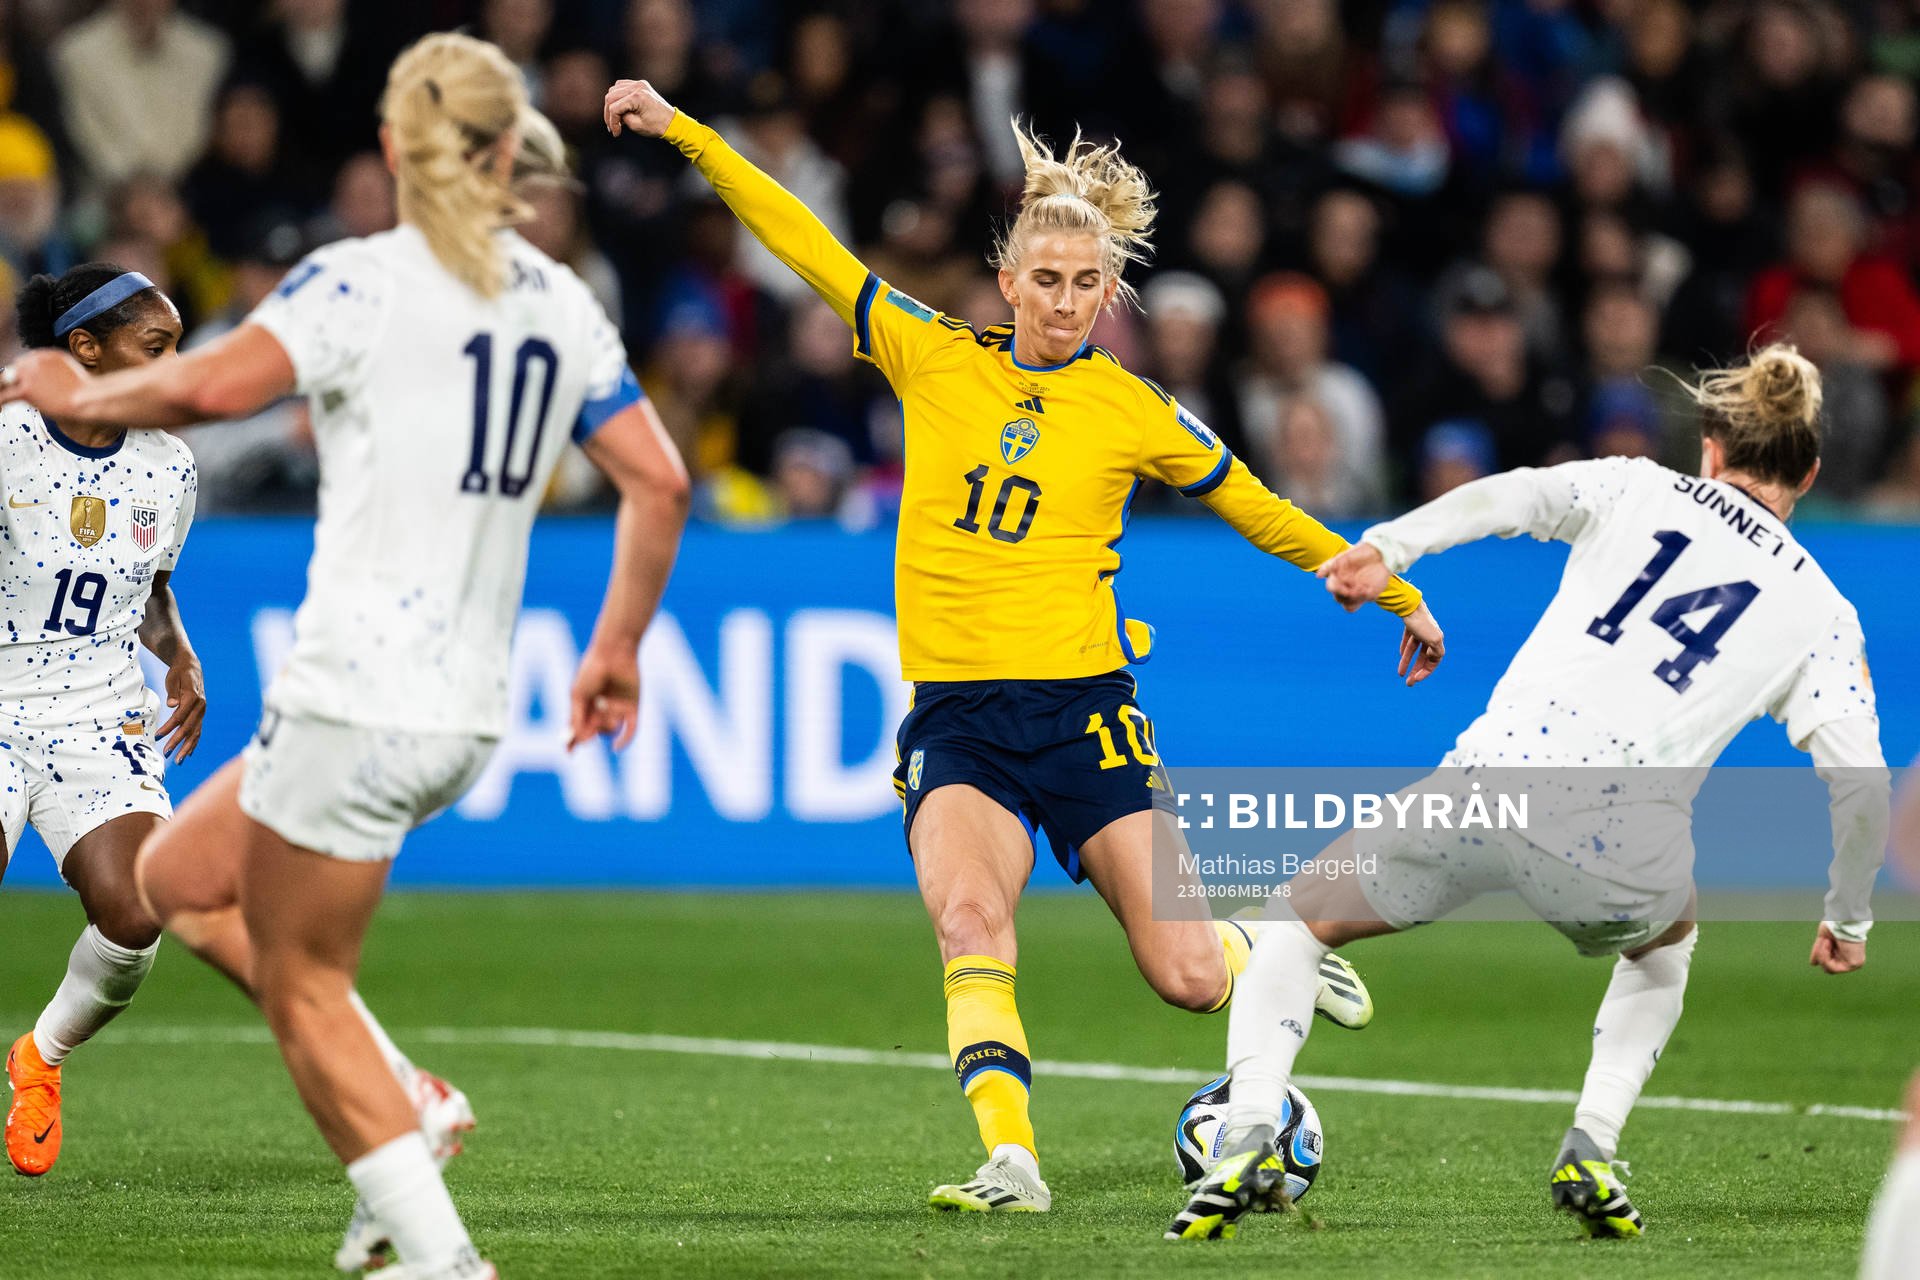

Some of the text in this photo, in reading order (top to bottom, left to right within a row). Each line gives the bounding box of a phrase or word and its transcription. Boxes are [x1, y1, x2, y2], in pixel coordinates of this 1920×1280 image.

[460, 333, 558, 498] 10
[79, 528, 95, 536] FIFA
[133, 509, 156, 527] USA
[953, 463, 1043, 544] 10
[43, 568, 108, 636] 19
[1585, 530, 1761, 694] 14
[1085, 704, 1159, 770] 10
